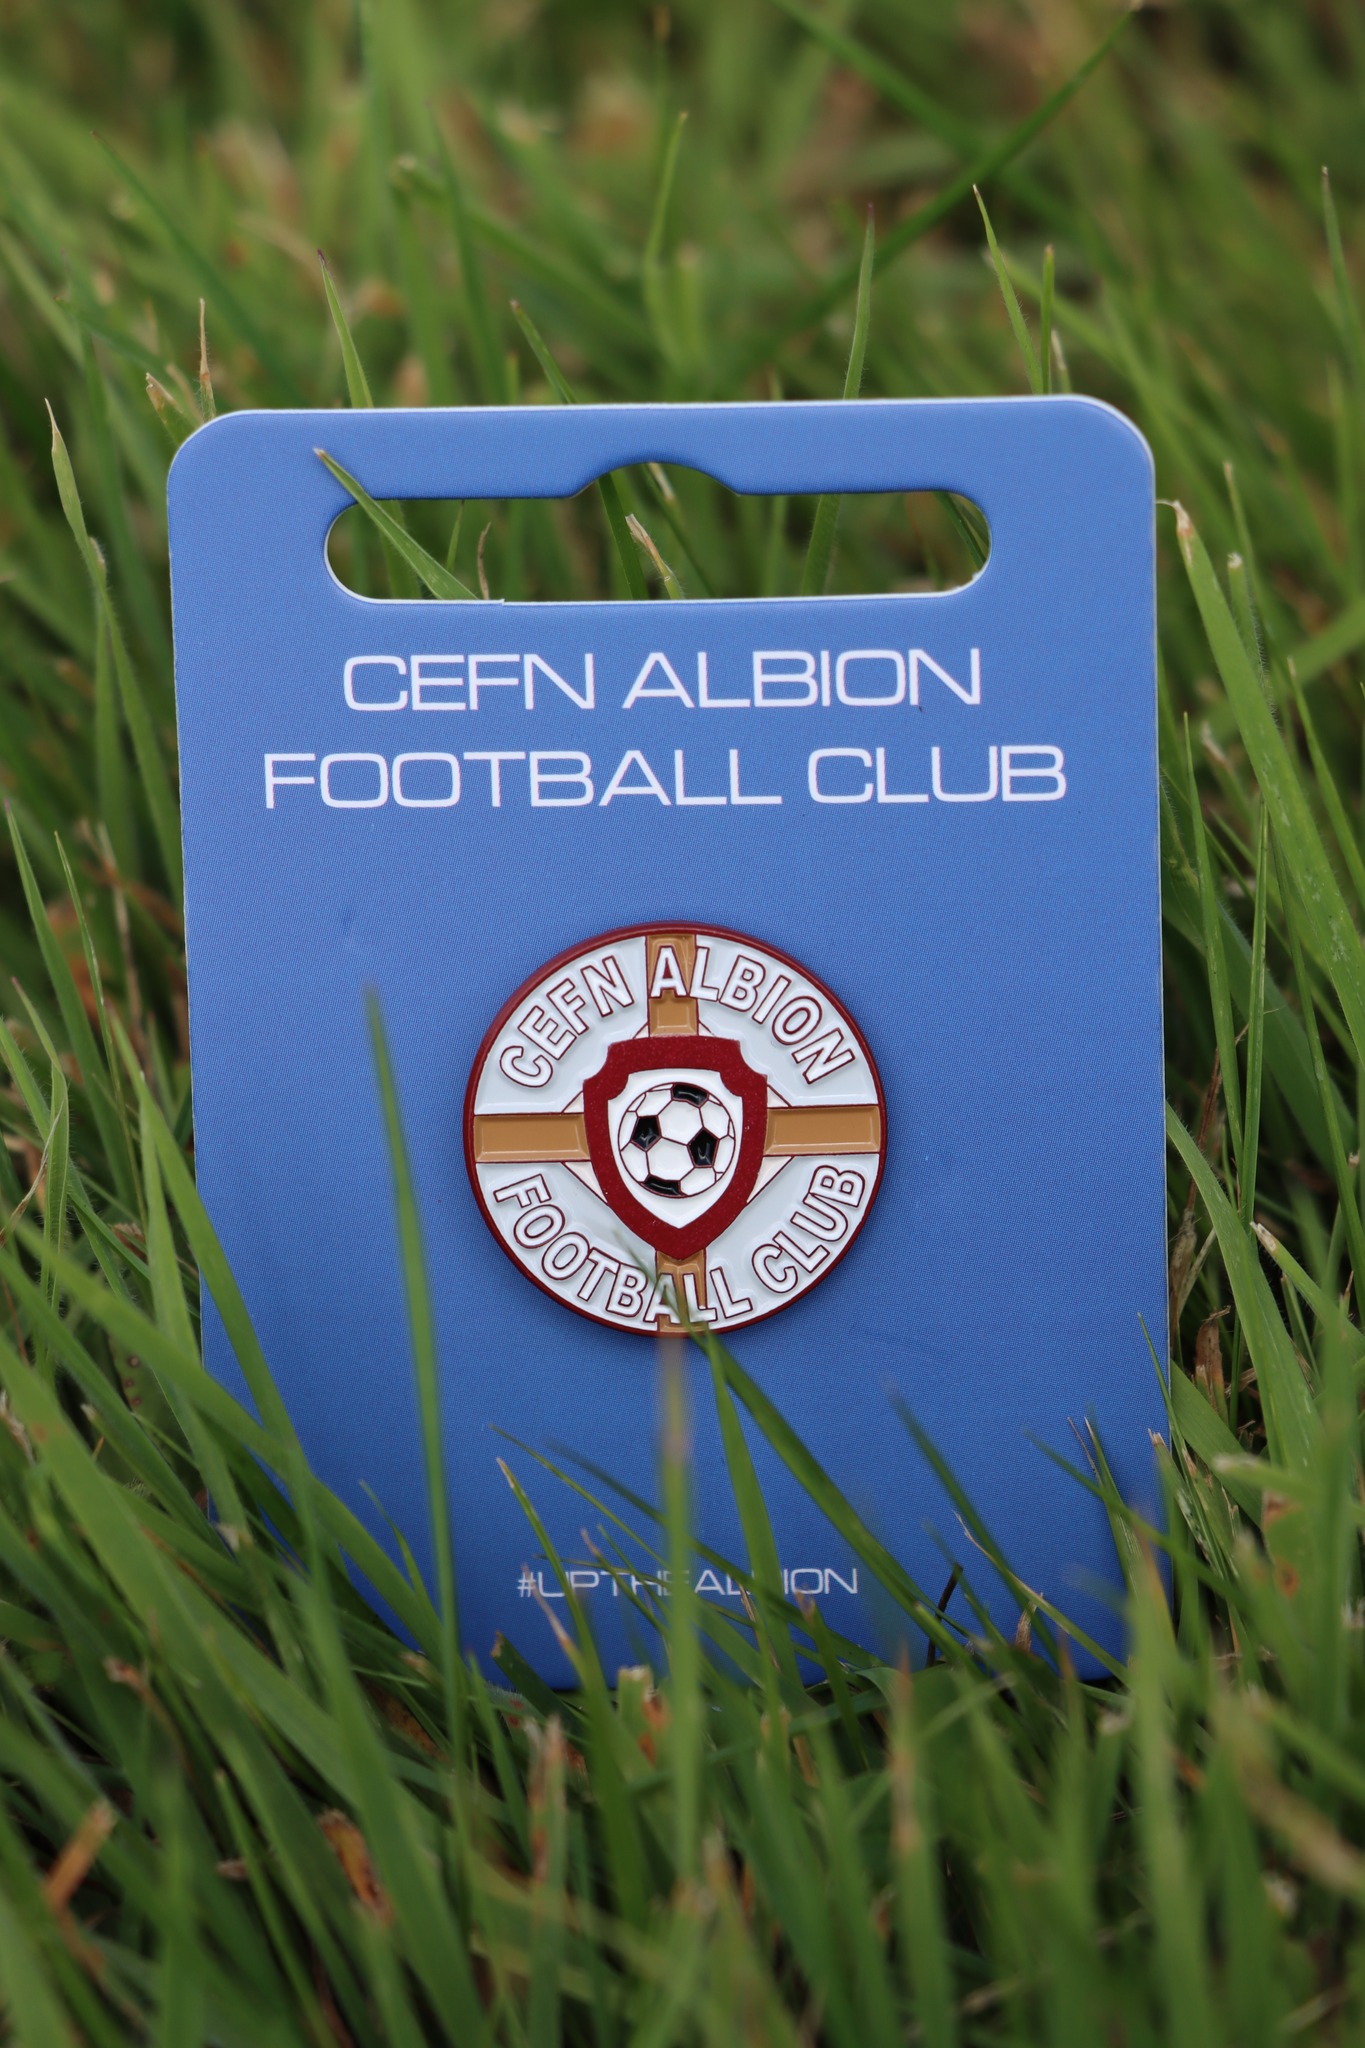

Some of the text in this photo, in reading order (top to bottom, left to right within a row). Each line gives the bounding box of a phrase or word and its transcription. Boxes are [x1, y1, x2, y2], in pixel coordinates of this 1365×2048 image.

[343, 648, 981, 712] CEFN ALBION
[264, 745, 1067, 809] FOOTBALL CLUB
[499, 945, 855, 1088] CEFN ALBION
[493, 1164, 866, 1324] FOOTBALL CLUB
[516, 1567, 859, 1599] #UPTHEALION
